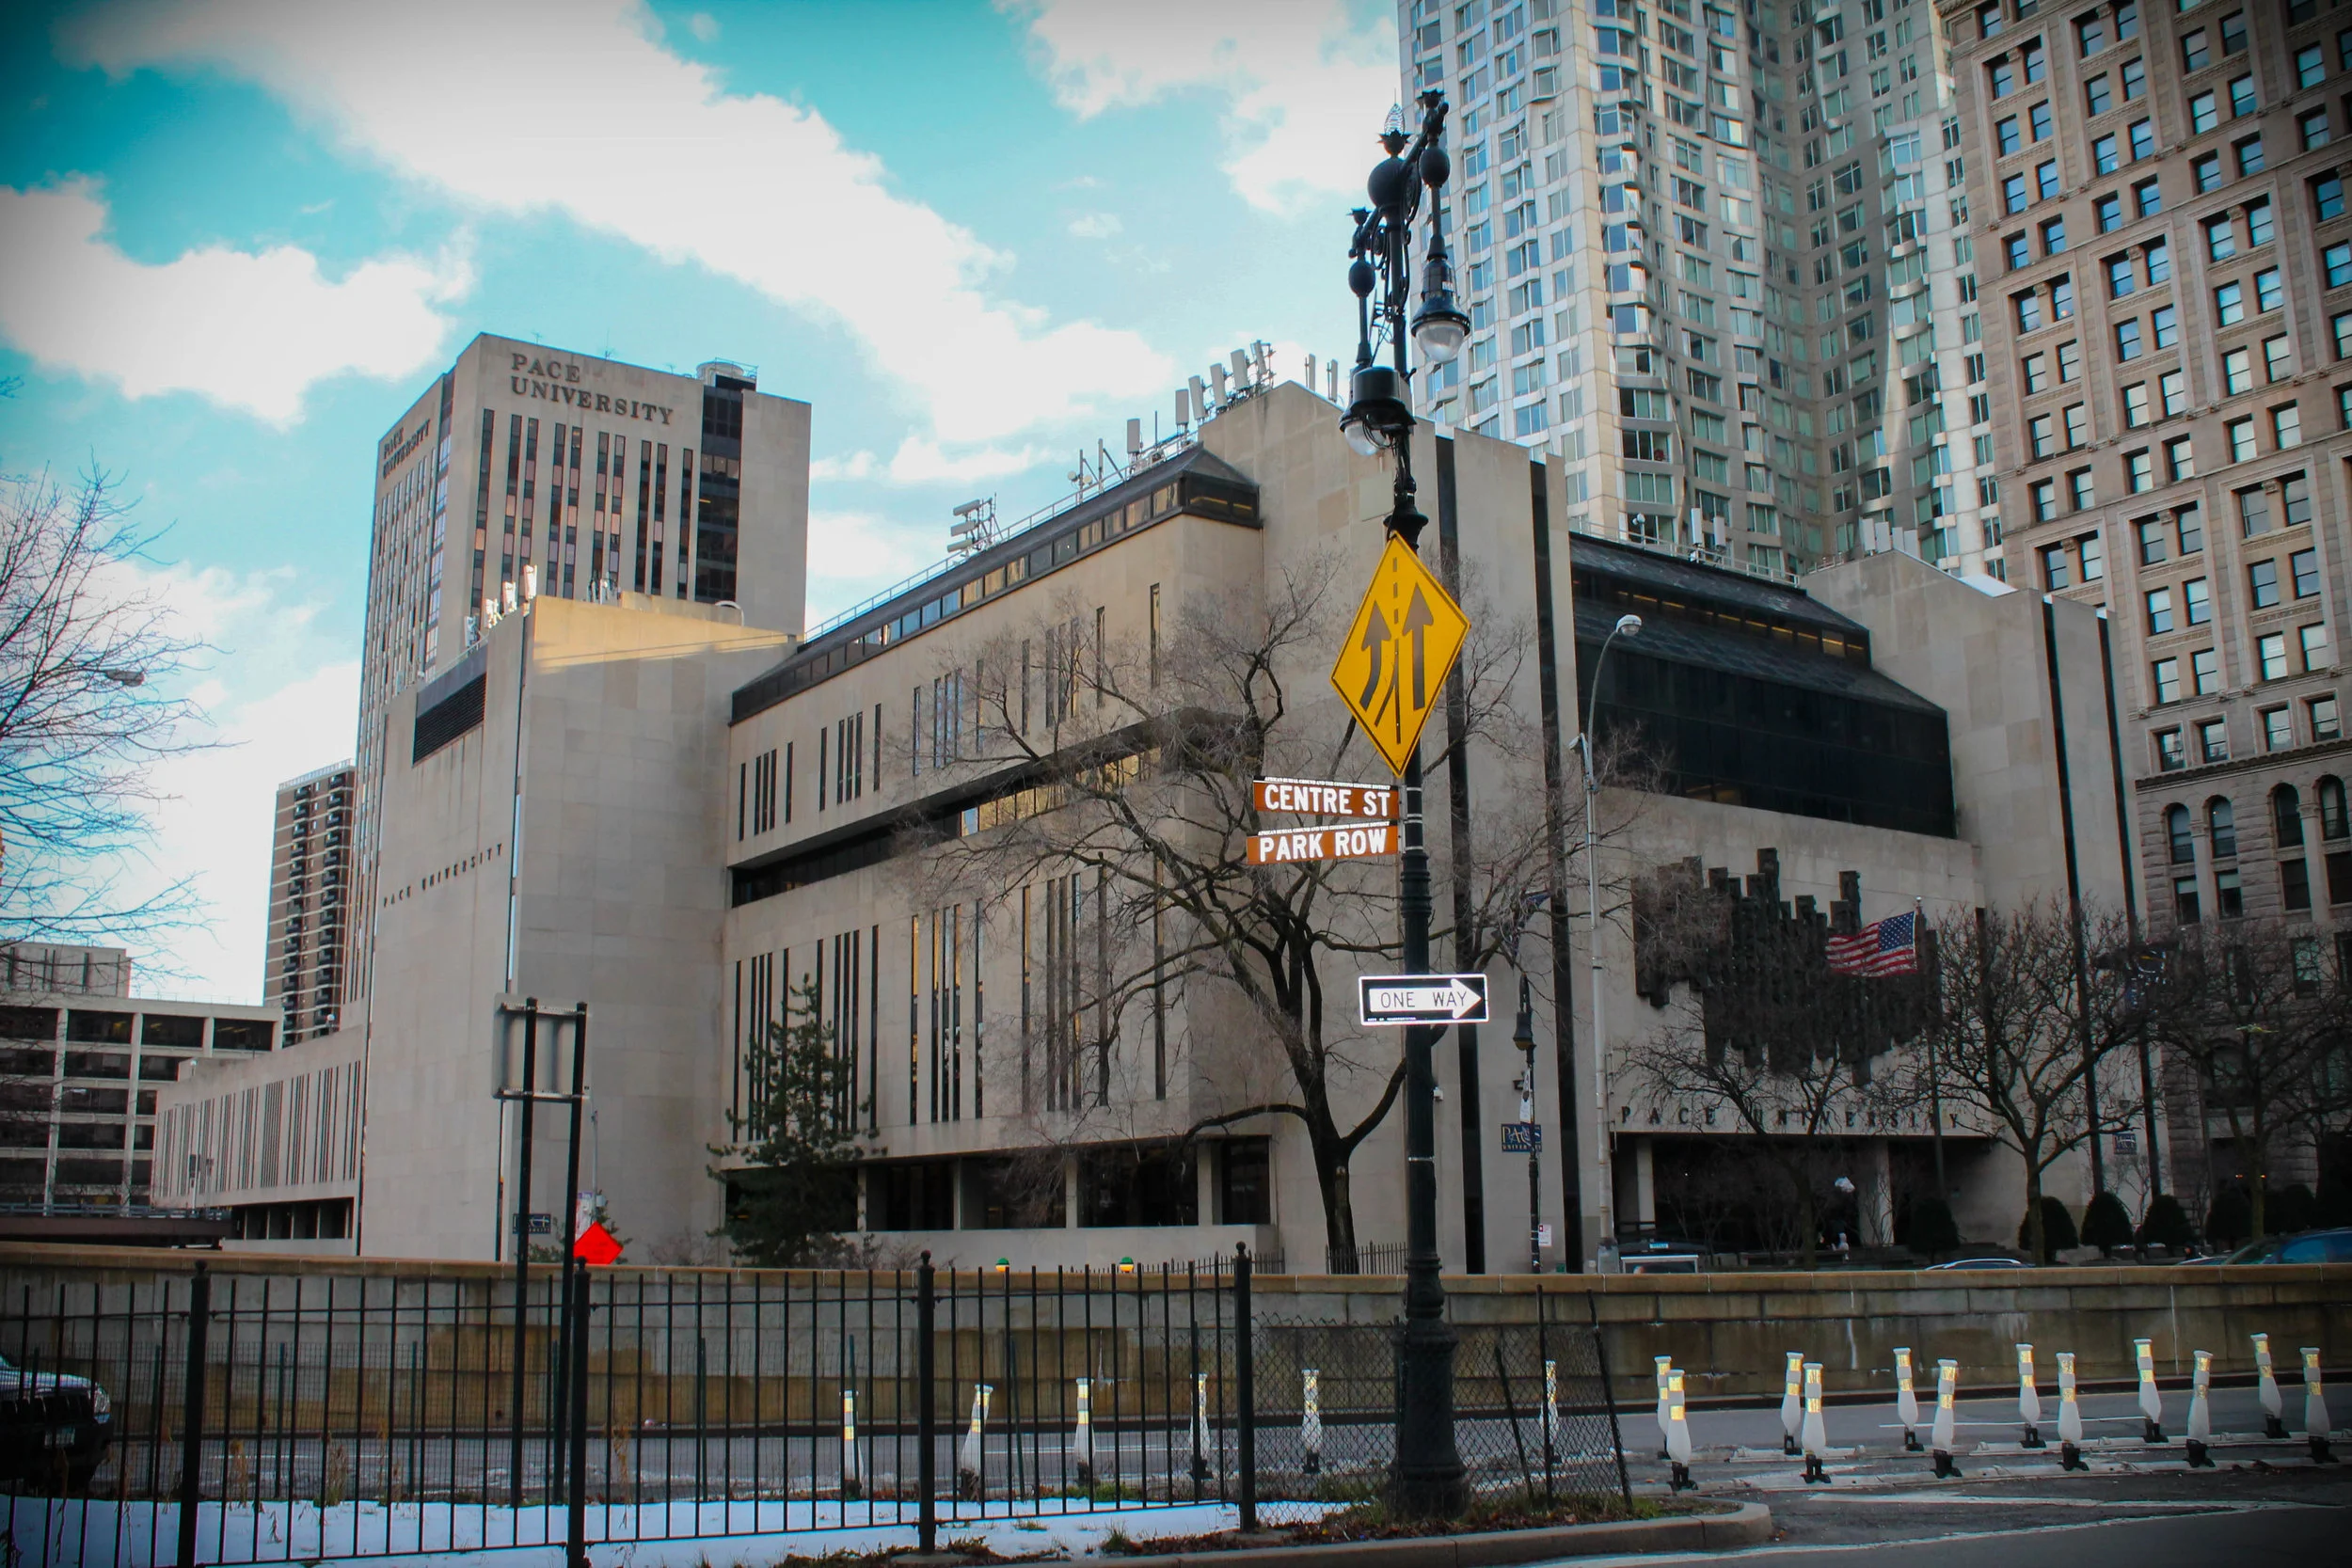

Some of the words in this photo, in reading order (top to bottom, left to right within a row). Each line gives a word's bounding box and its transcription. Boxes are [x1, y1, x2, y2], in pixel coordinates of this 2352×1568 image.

[511, 353, 580, 383] PACE
[511, 376, 674, 425] UNIVERSITY
[1264, 784, 1353, 815] CENTRE
[1363, 790, 1391, 816] ST
[1260, 832, 1324, 863] PARK
[1334, 828, 1387, 857] ROW
[383, 885, 412, 908] PACE
[421, 843, 503, 891] UNIVERSITY
[1380, 991, 1416, 1008] ONE
[1433, 990, 1468, 1007] WAY
[1621, 1105, 1716, 1125] PACE
